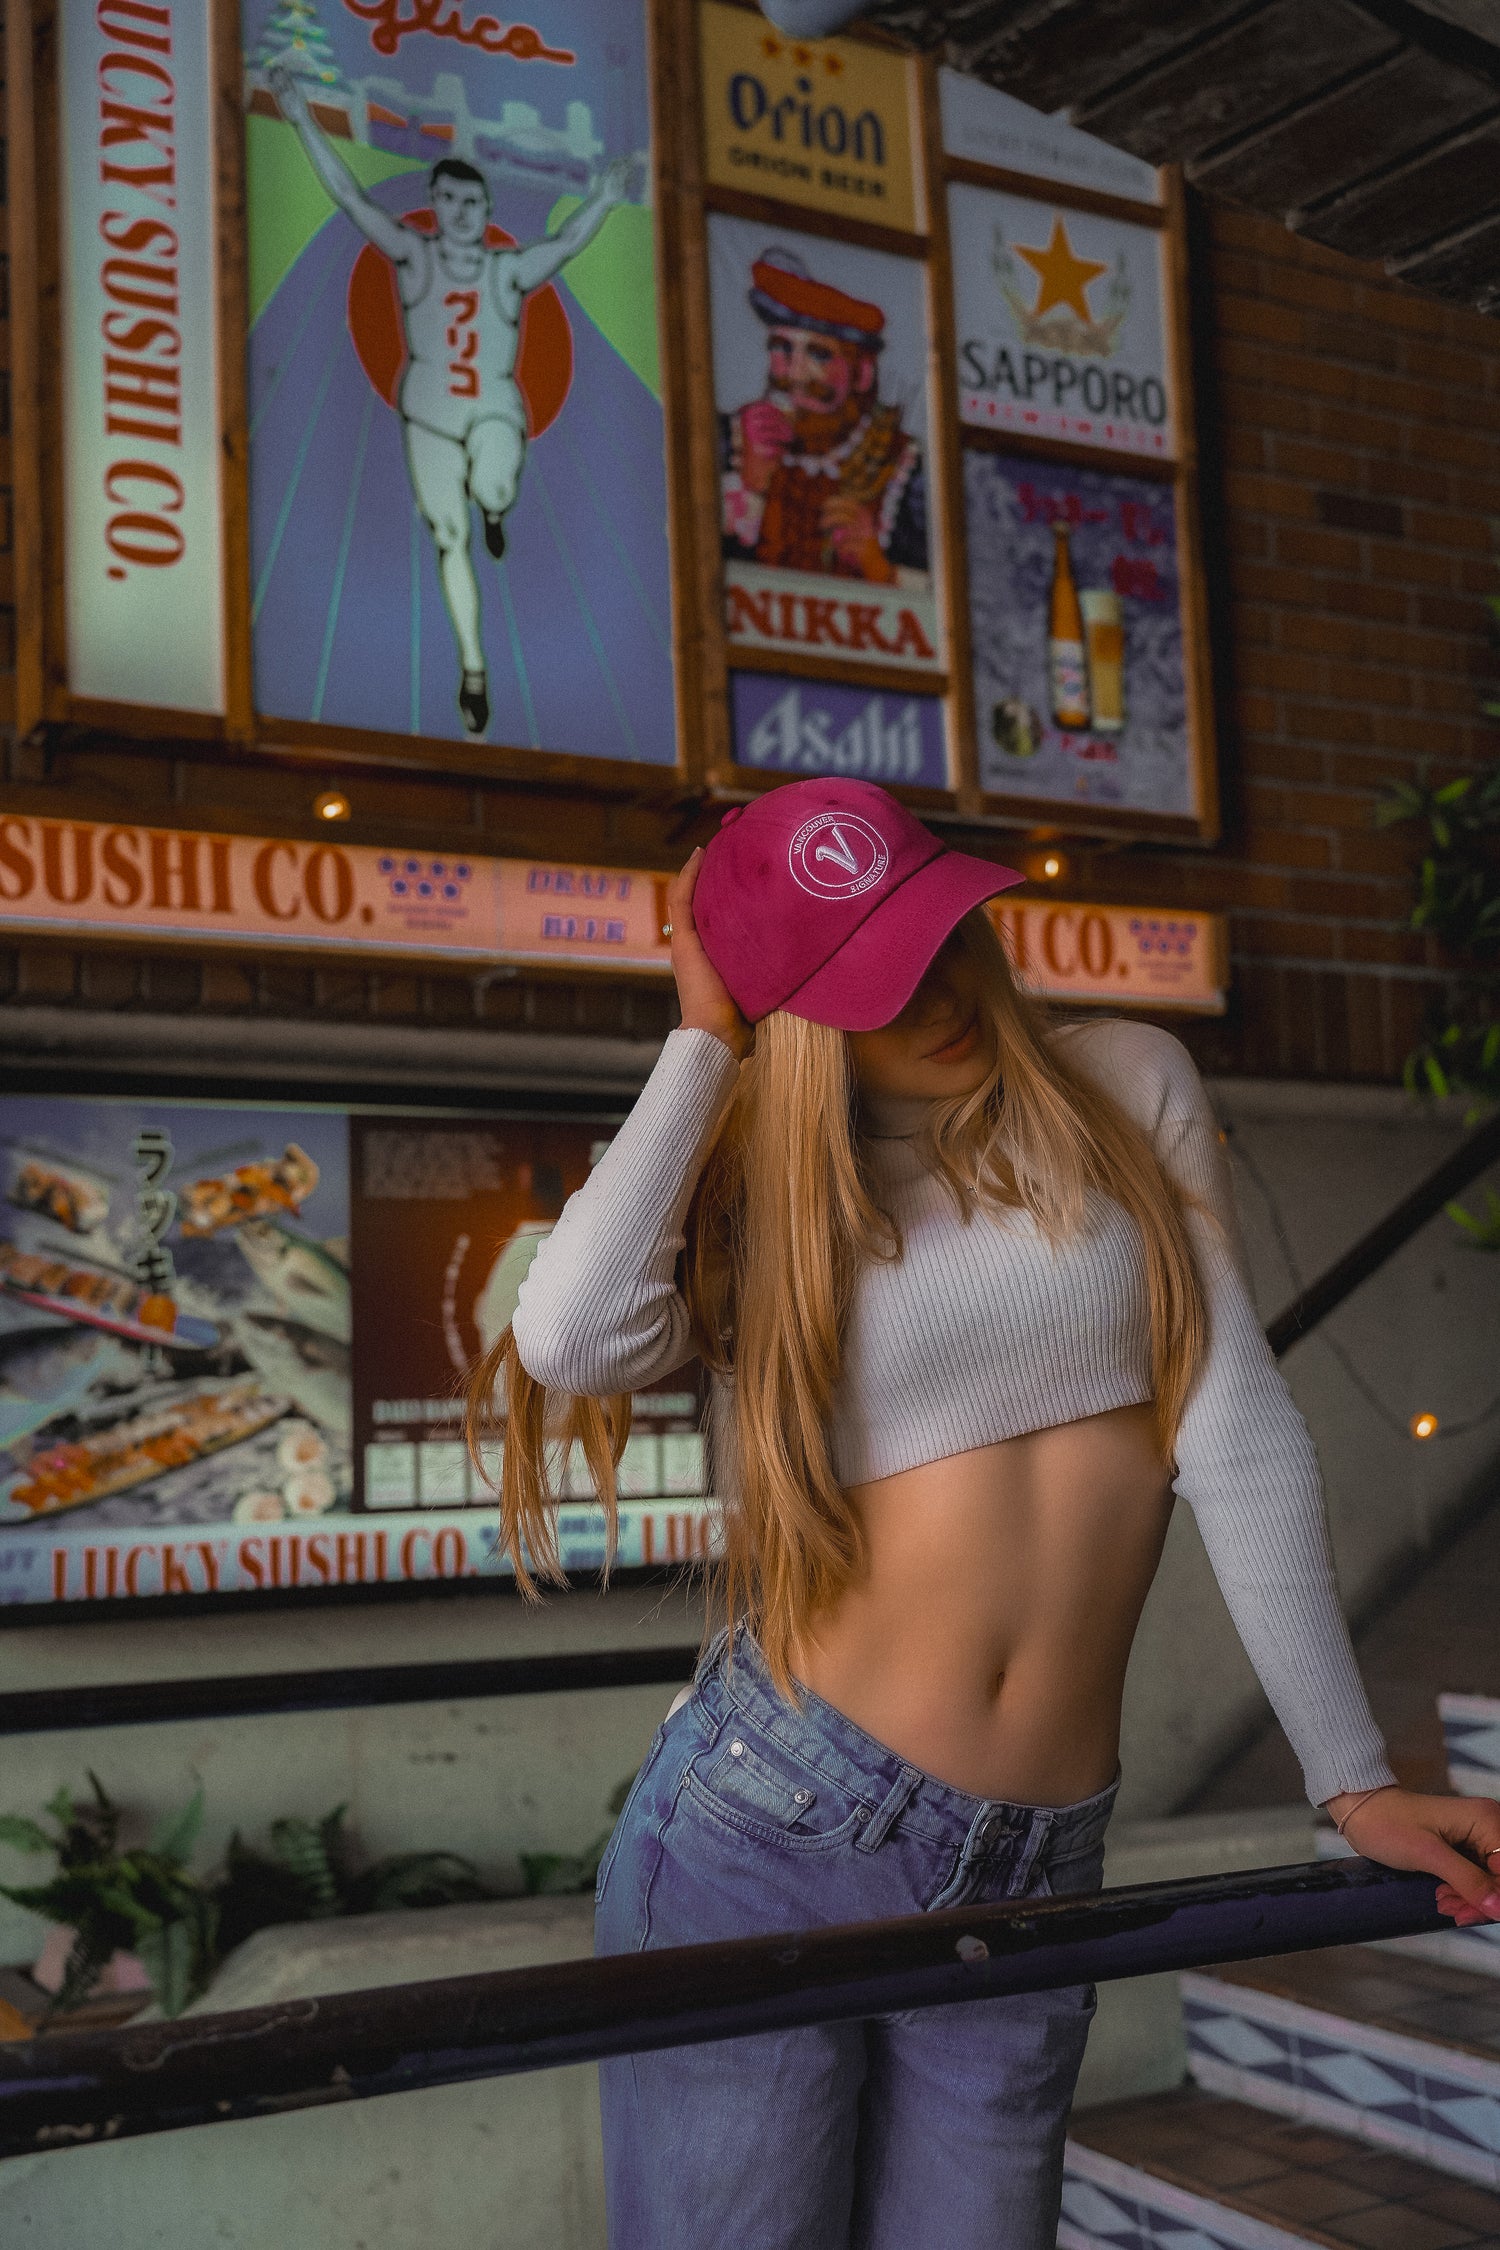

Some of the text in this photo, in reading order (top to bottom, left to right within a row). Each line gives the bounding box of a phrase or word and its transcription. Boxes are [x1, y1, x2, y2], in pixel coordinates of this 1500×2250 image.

[728, 71, 886, 166] Orion
[728, 146, 886, 197] ORION BEER
[99, 211, 183, 446] SUSHI
[961, 340, 1167, 425] SAPPORO
[104, 458, 186, 582] CO.
[728, 585, 936, 659] NIKKA
[747, 685, 923, 779] Asahi
[0, 812, 376, 925] SUSHI CO.
[794, 815, 835, 855] VANCOUVER
[850, 854, 887, 893] SIGNATURE
[1041, 906, 1130, 979] CO.
[51, 1539, 227, 1601] LUCKY
[237, 1530, 389, 1589] SUSHI
[399, 1525, 478, 1580] CO.
